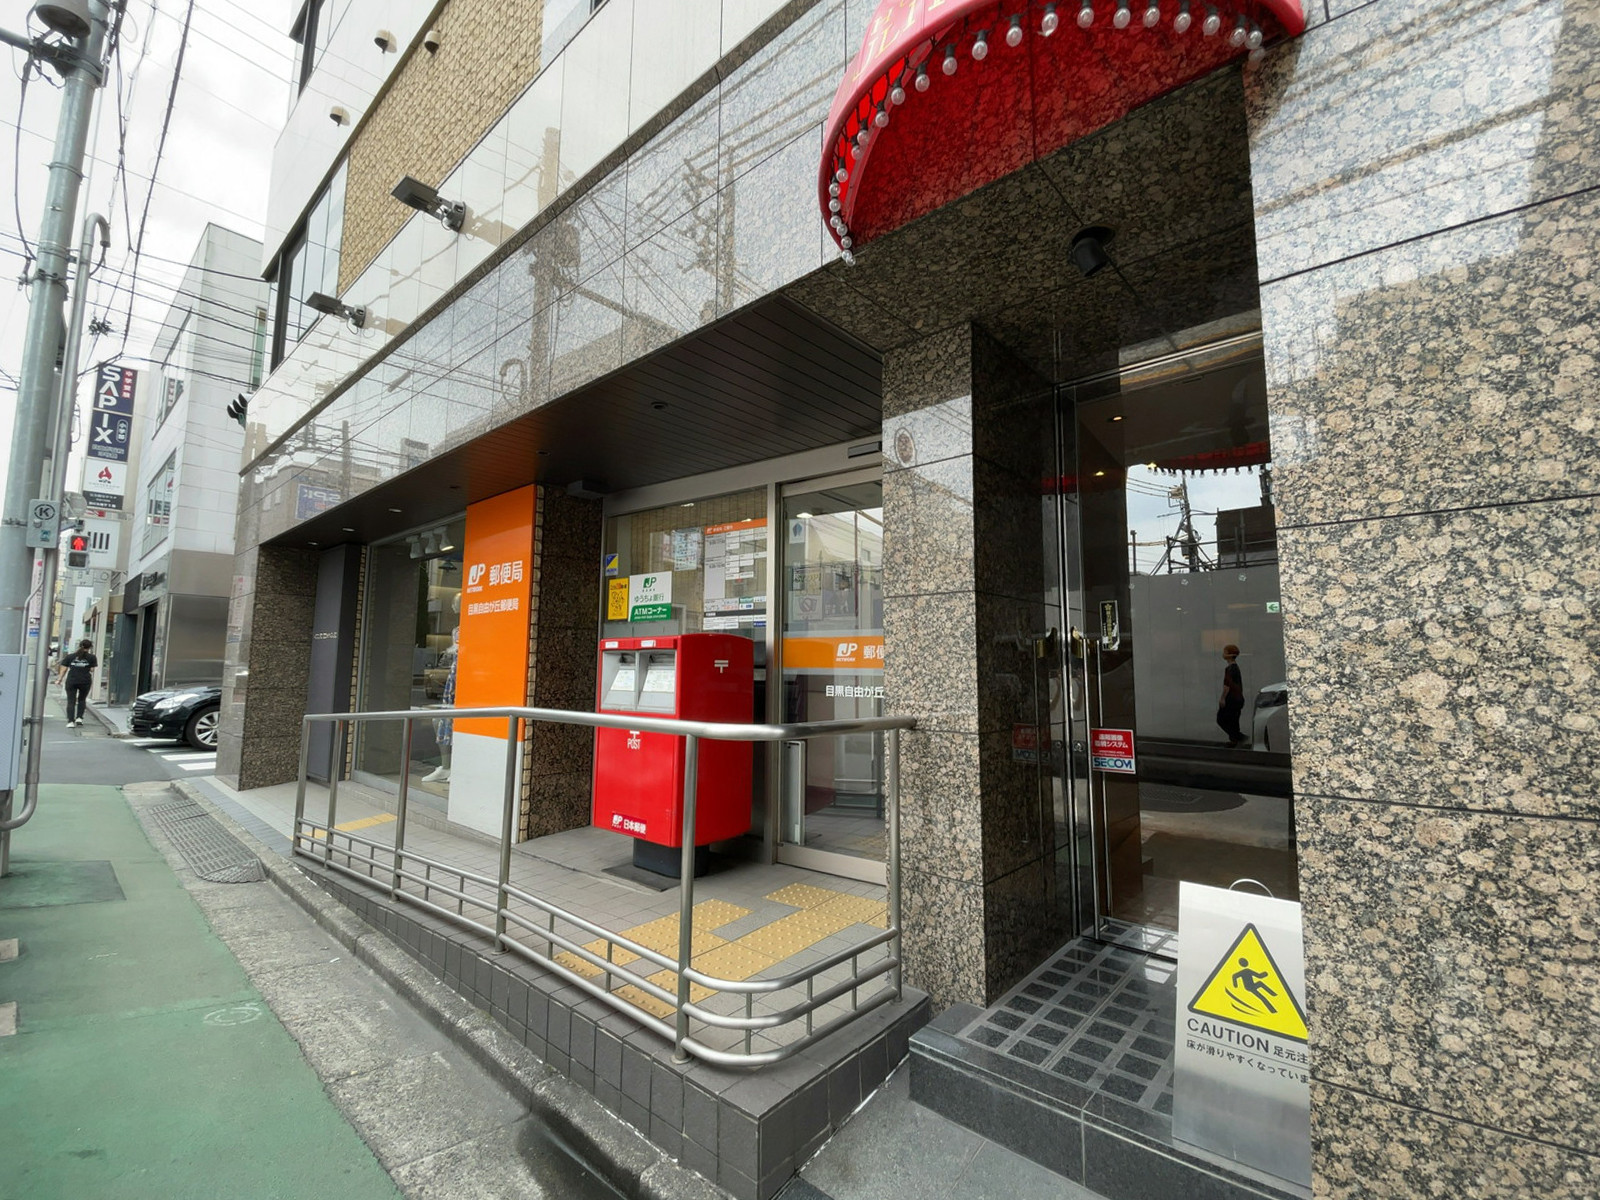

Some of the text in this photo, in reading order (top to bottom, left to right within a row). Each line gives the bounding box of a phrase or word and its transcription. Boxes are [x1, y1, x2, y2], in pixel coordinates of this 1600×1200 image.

[94, 365, 121, 444] SAPIX
[468, 560, 523, 586] JP 郵便局
[643, 577, 657, 588] JP
[634, 593, 665, 603] ゆうちょ銀行
[468, 598, 519, 615] 目黒自由が丘郵便局
[634, 606, 668, 616] ATMコーナー
[836, 642, 858, 657] JP
[825, 685, 885, 698] 目黒自由が丘
[627, 738, 640, 750] POST
[1094, 757, 1132, 769] SECOM
[623, 818, 646, 835] 日本郵便
[1187, 1018, 1308, 1065] CAUTION 足元注
[1186, 1039, 1309, 1085] 床が滑りやすくなっていま
